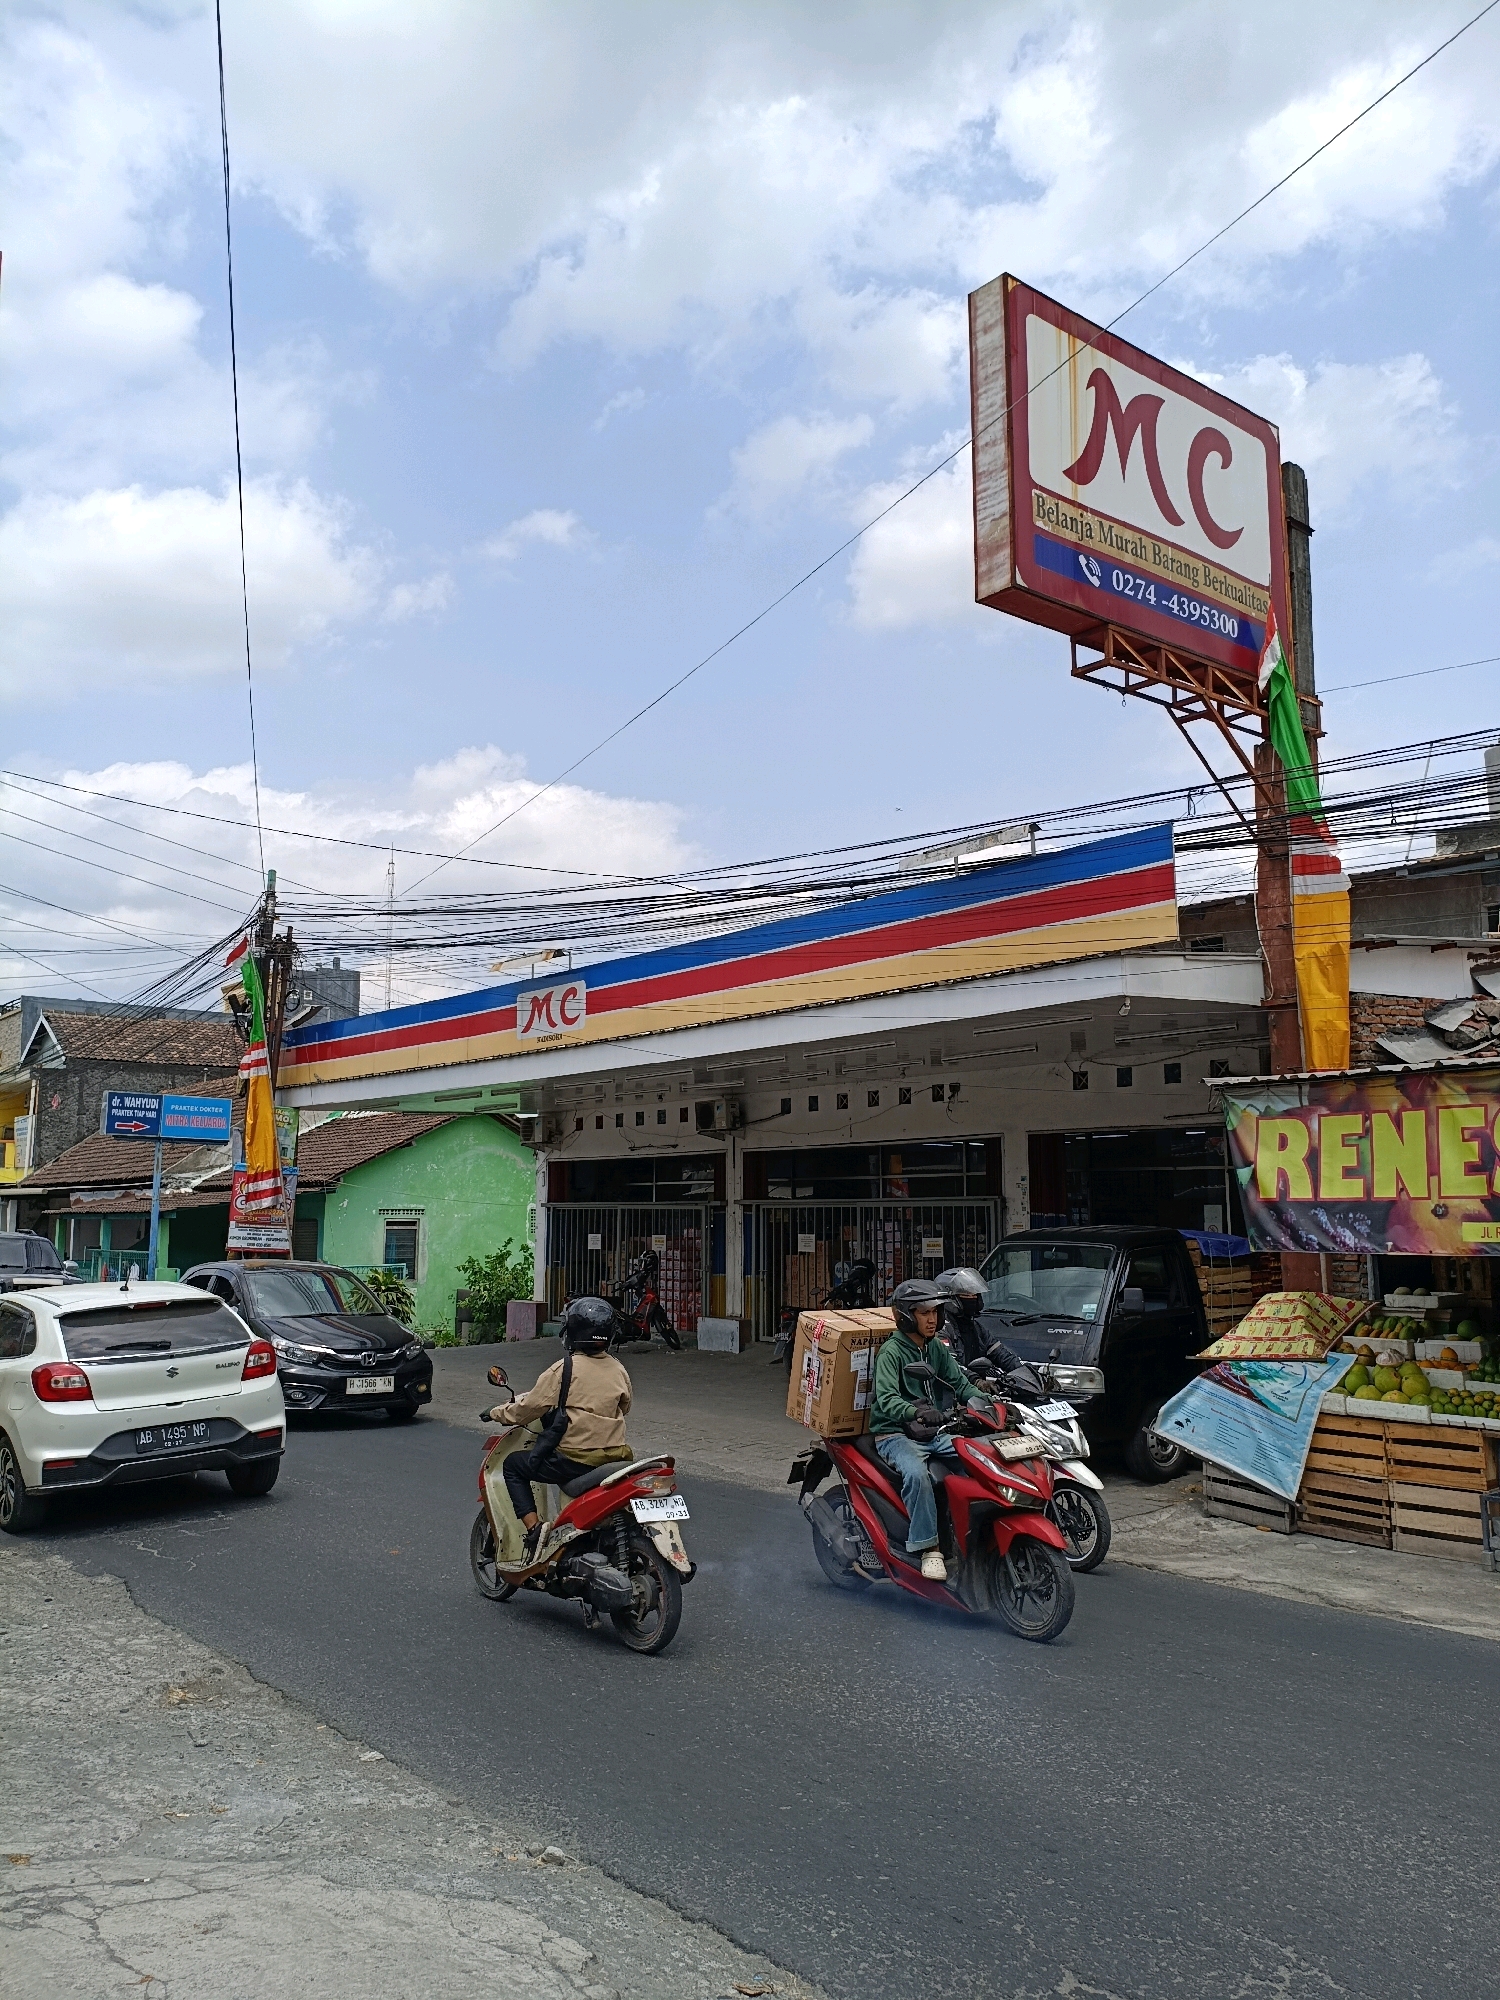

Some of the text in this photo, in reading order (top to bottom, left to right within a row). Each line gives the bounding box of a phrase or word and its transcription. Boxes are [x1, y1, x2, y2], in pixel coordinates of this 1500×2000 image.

[1062, 367, 1244, 550] MC
[1034, 492, 1269, 615] Belanja Murah Barang Berkualitas
[1112, 569, 1238, 639] 0274 -4395300
[521, 986, 580, 1033] MC
[112, 1096, 159, 1109] dr. WAHYUDI
[111, 1109, 134, 1117] PRAKTEK
[165, 1114, 227, 1129] MITRA KELUARGA
[215, 1361, 241, 1369] BALENO
[349, 1379, 355, 1389] H
[140, 1422, 206, 1445] AB 1495 NP
[634, 1500, 646, 1511] AB
[648, 1498, 668, 1509] 3287
